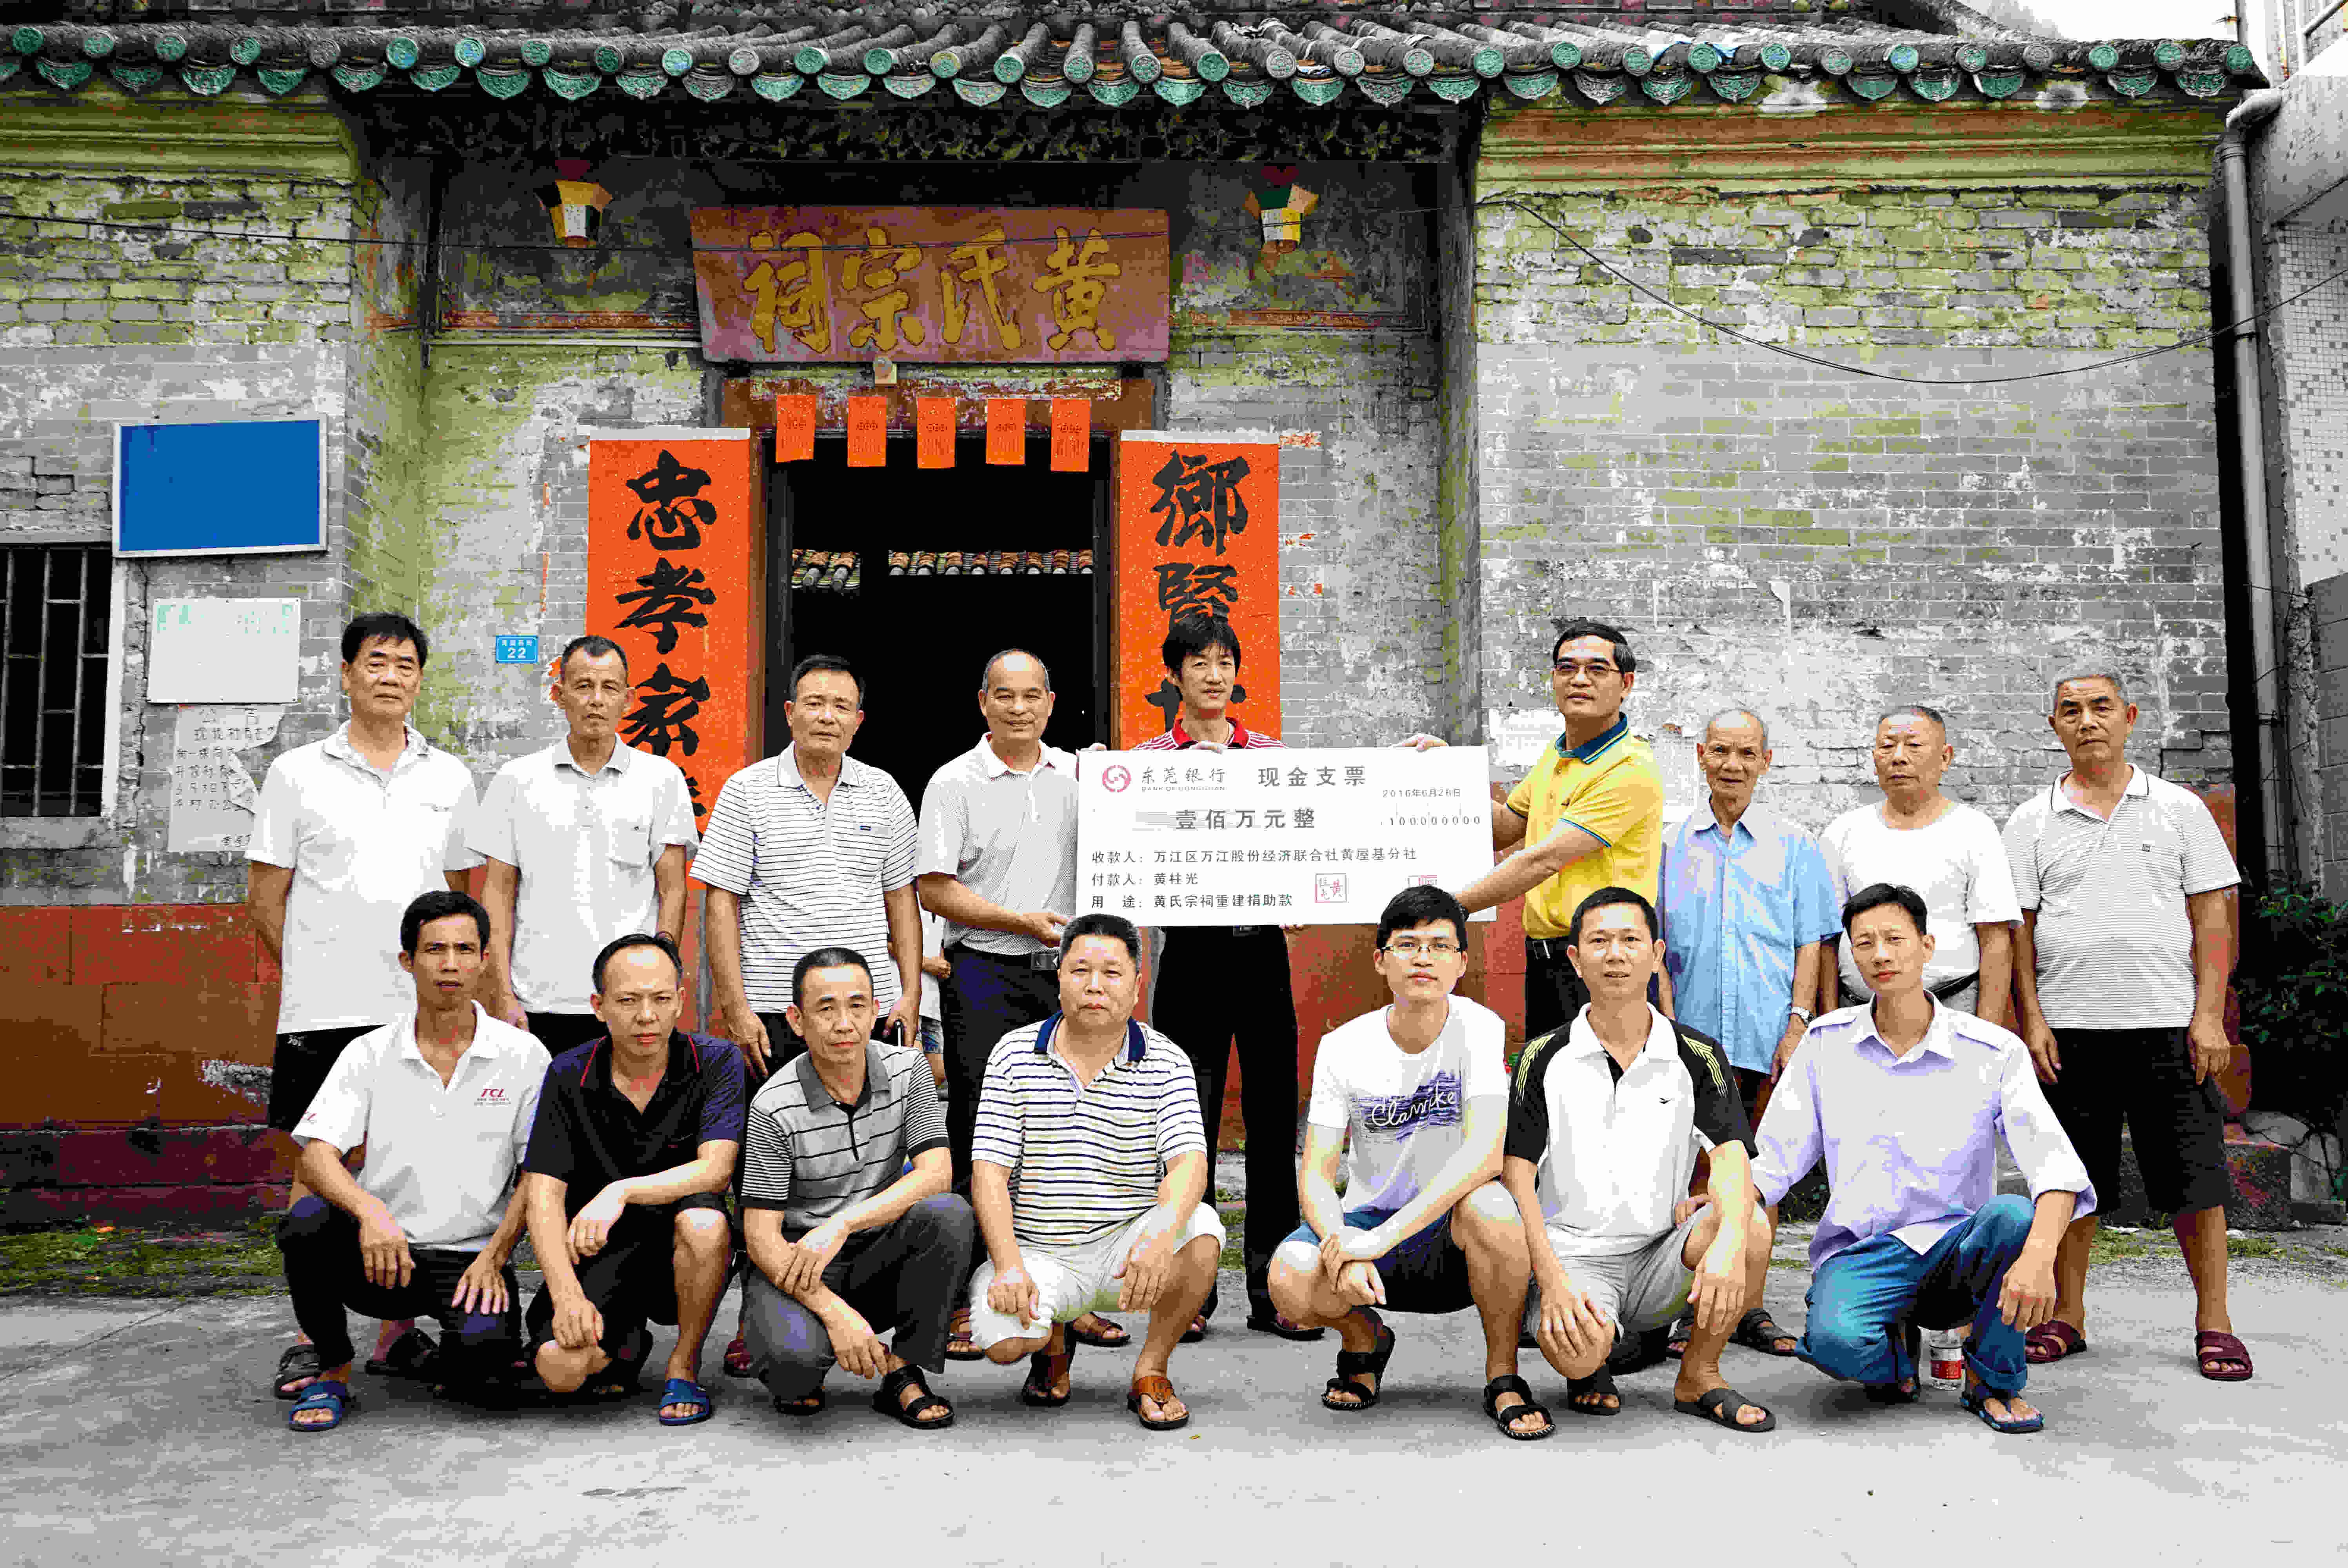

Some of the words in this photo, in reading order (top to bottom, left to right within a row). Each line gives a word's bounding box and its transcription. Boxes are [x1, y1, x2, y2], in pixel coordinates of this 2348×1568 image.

[1144, 451, 1251, 731] 鄉賢
[614, 450, 717, 817] 忠孝家
[508, 648, 526, 659] 22
[1141, 766, 1226, 784] 东莞银行
[1258, 766, 1365, 787] 现金支票
[1176, 808, 1315, 830] 壹佰万元整
[481, 1088, 504, 1097] TCL
